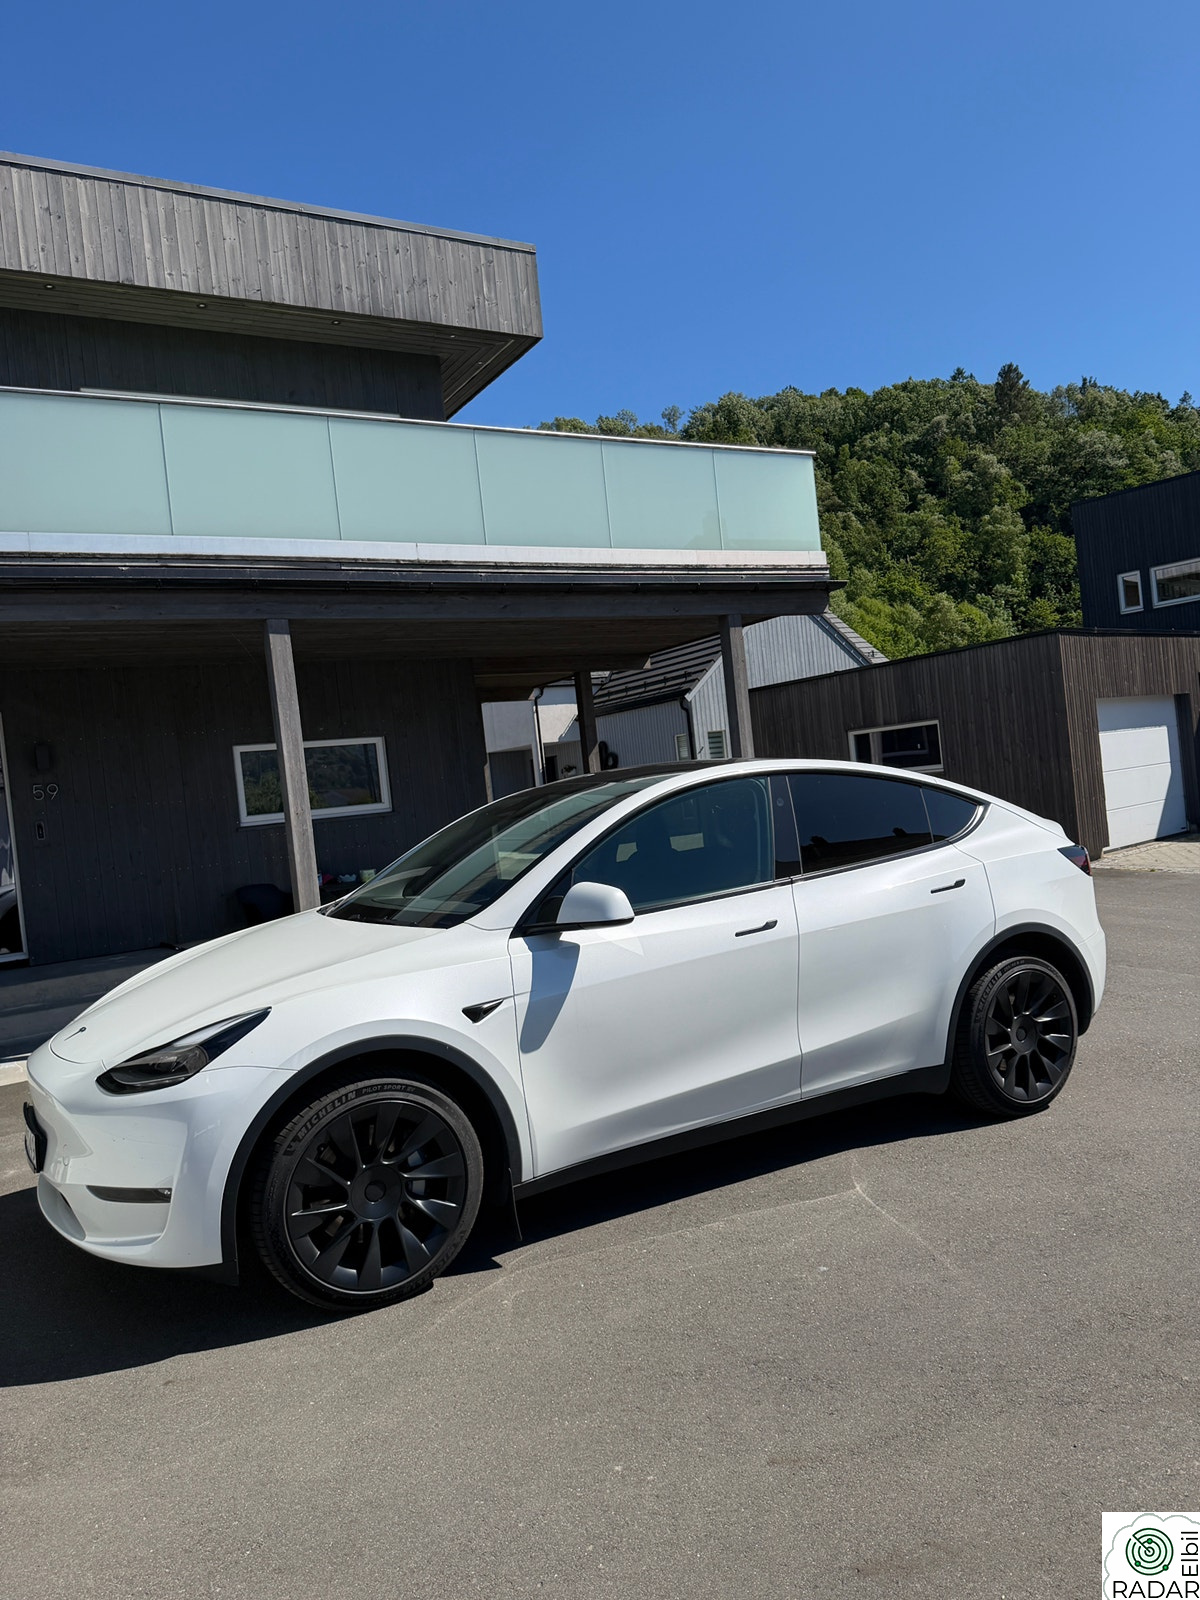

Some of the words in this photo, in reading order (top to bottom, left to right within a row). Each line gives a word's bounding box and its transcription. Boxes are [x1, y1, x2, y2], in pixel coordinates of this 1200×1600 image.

[32, 783, 59, 801] 59
[979, 970, 1003, 1010] MICHELIN
[296, 1090, 358, 1142] MICHELIN
[362, 1085, 382, 1094] PILOT
